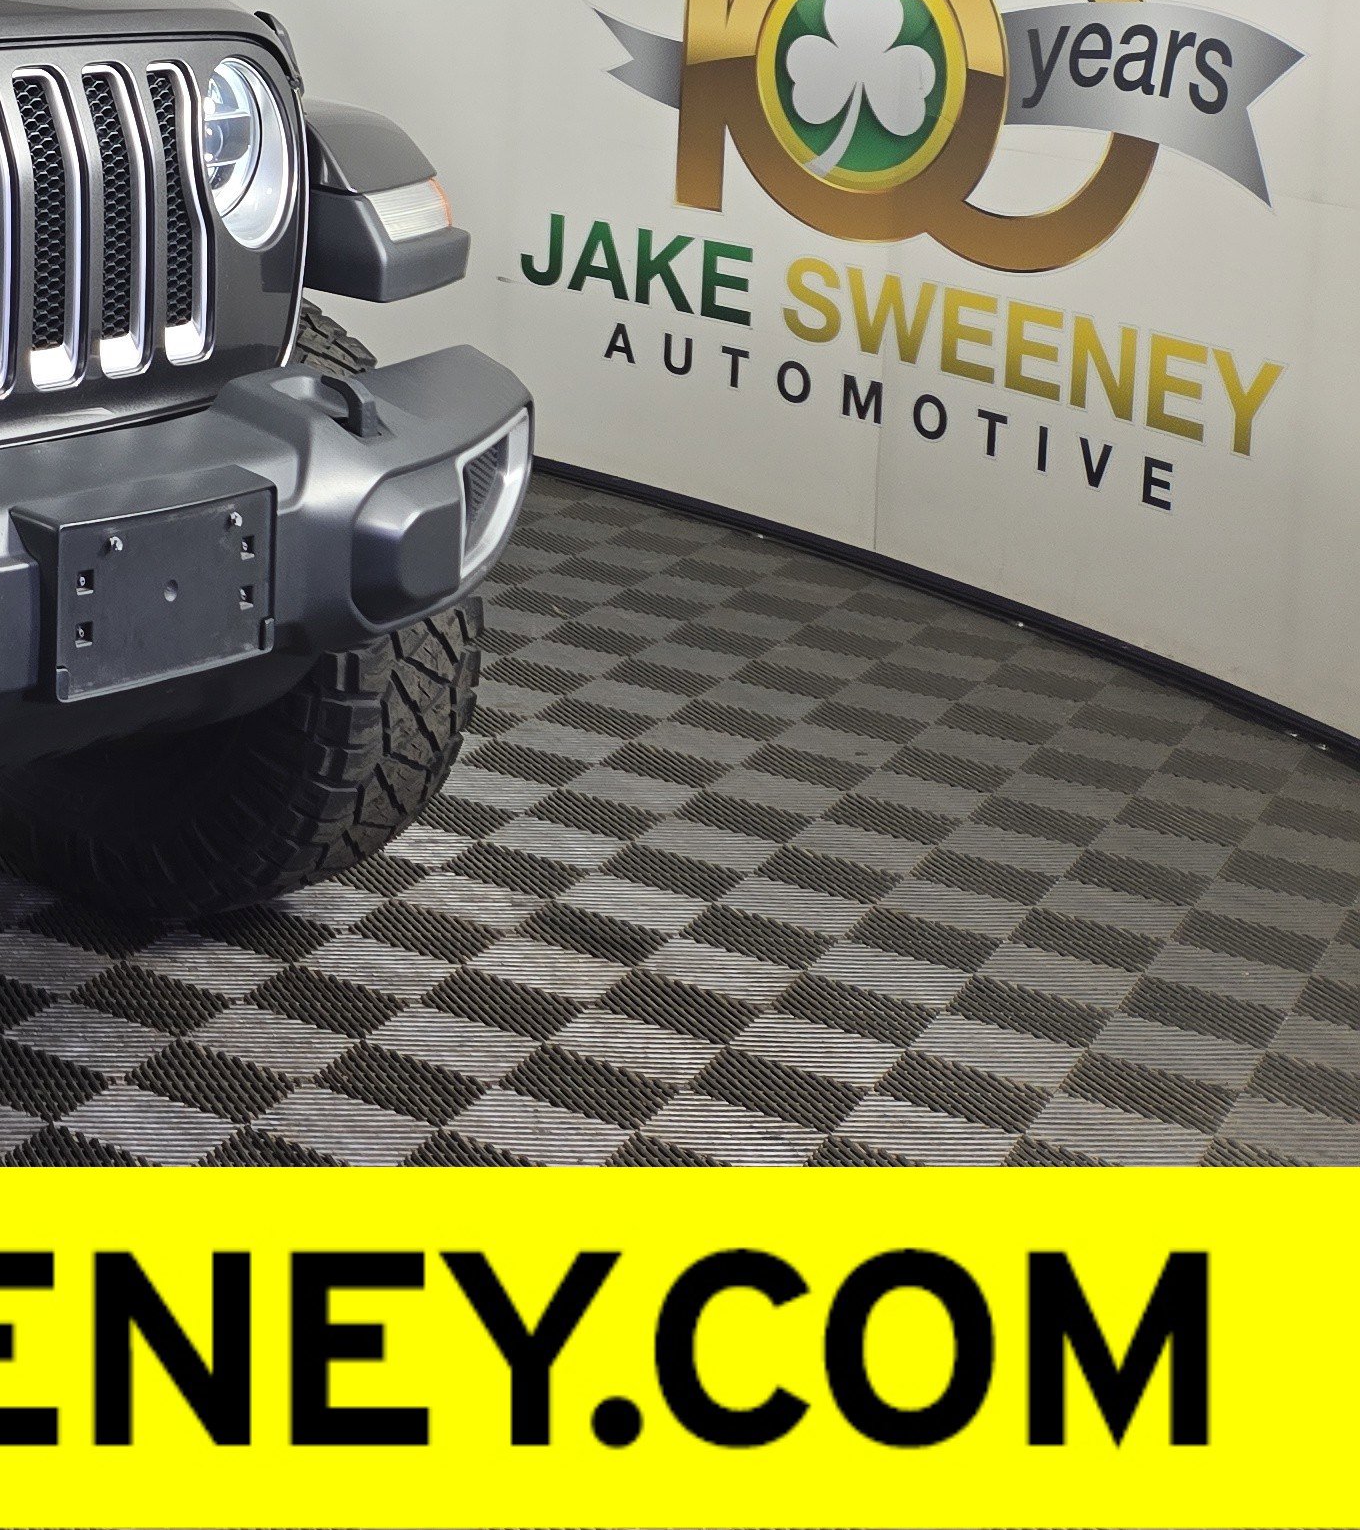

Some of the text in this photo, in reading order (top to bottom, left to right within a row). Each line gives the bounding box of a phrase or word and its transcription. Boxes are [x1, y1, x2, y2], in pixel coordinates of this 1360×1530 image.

[1020, 22, 1234, 116] years
[519, 212, 1285, 457] JAKE SWEENEY
[604, 321, 1175, 511] AUTOMOTIVE
